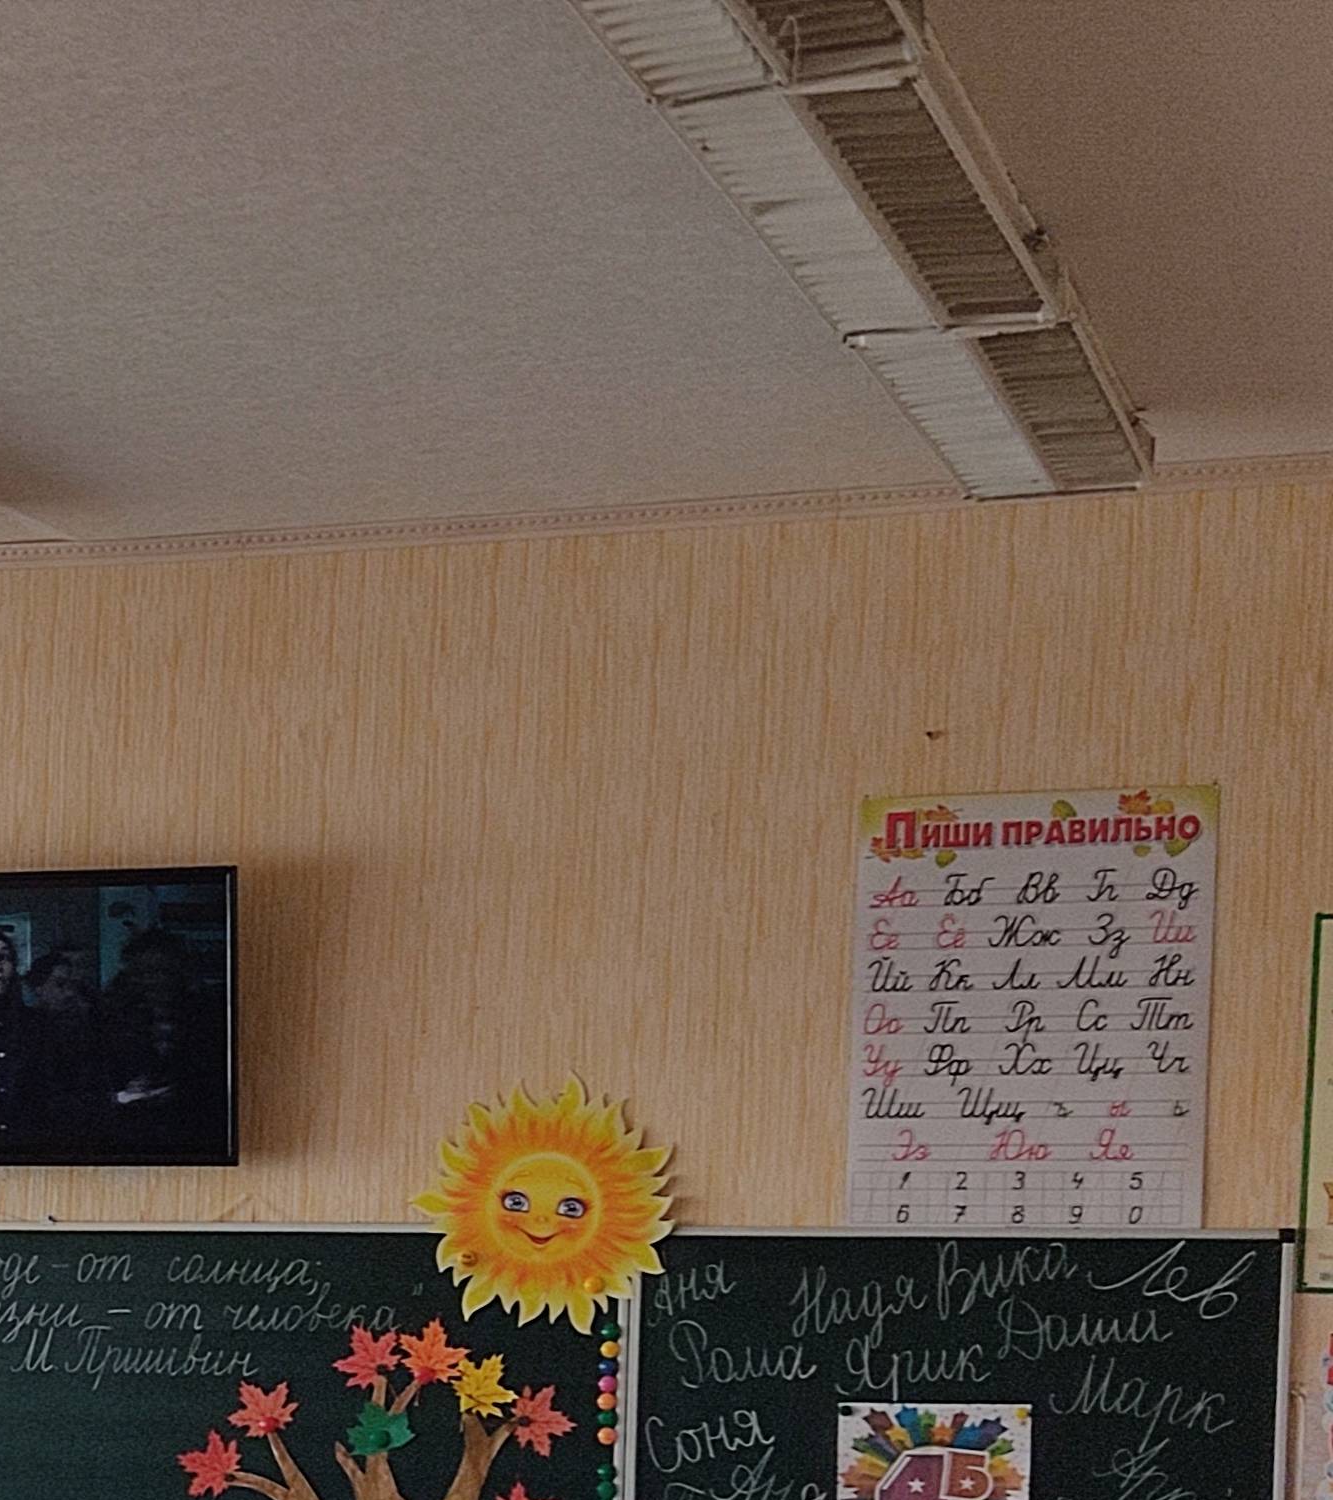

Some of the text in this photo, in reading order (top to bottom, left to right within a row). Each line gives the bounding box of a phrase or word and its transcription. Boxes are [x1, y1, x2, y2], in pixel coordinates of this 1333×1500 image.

[1001, 815, 1201, 847] ПРАВИЛЬНО
[869, 868, 1199, 909] Аа Бб Вв Гг Дд
[869, 911, 1195, 959] Ее Ёё Жж Зз Ии
[868, 954, 1195, 992] Йй Кк Лл Мм Нн
[864, 997, 1194, 1041] Оо Пп Рр Сс Тт
[864, 1041, 1190, 1087] Уу Фф Хх Цц Чч
[899, 1172, 1142, 1190] 1 2 3 4 5
[896, 1205, 1141, 1224] 6 7 8 9 0
[76, 1253, 134, 1282] от
[648, 1259, 736, 1327] Аня
[937, 1240, 1078, 1321] Вика
[1087, 1240, 1257, 1319] Лев
[144, 1300, 203, 1331] от
[790, 1265, 928, 1349] Надя
[997, 1298, 1173, 1360] Даша
[65, 1324, 259, 1390] Пришвин
[669, 1319, 818, 1389] Рома
[836, 1335, 992, 1401] Ярик
[1048, 1354, 1234, 1453] Марк
[644, 1409, 776, 1473] Соня
